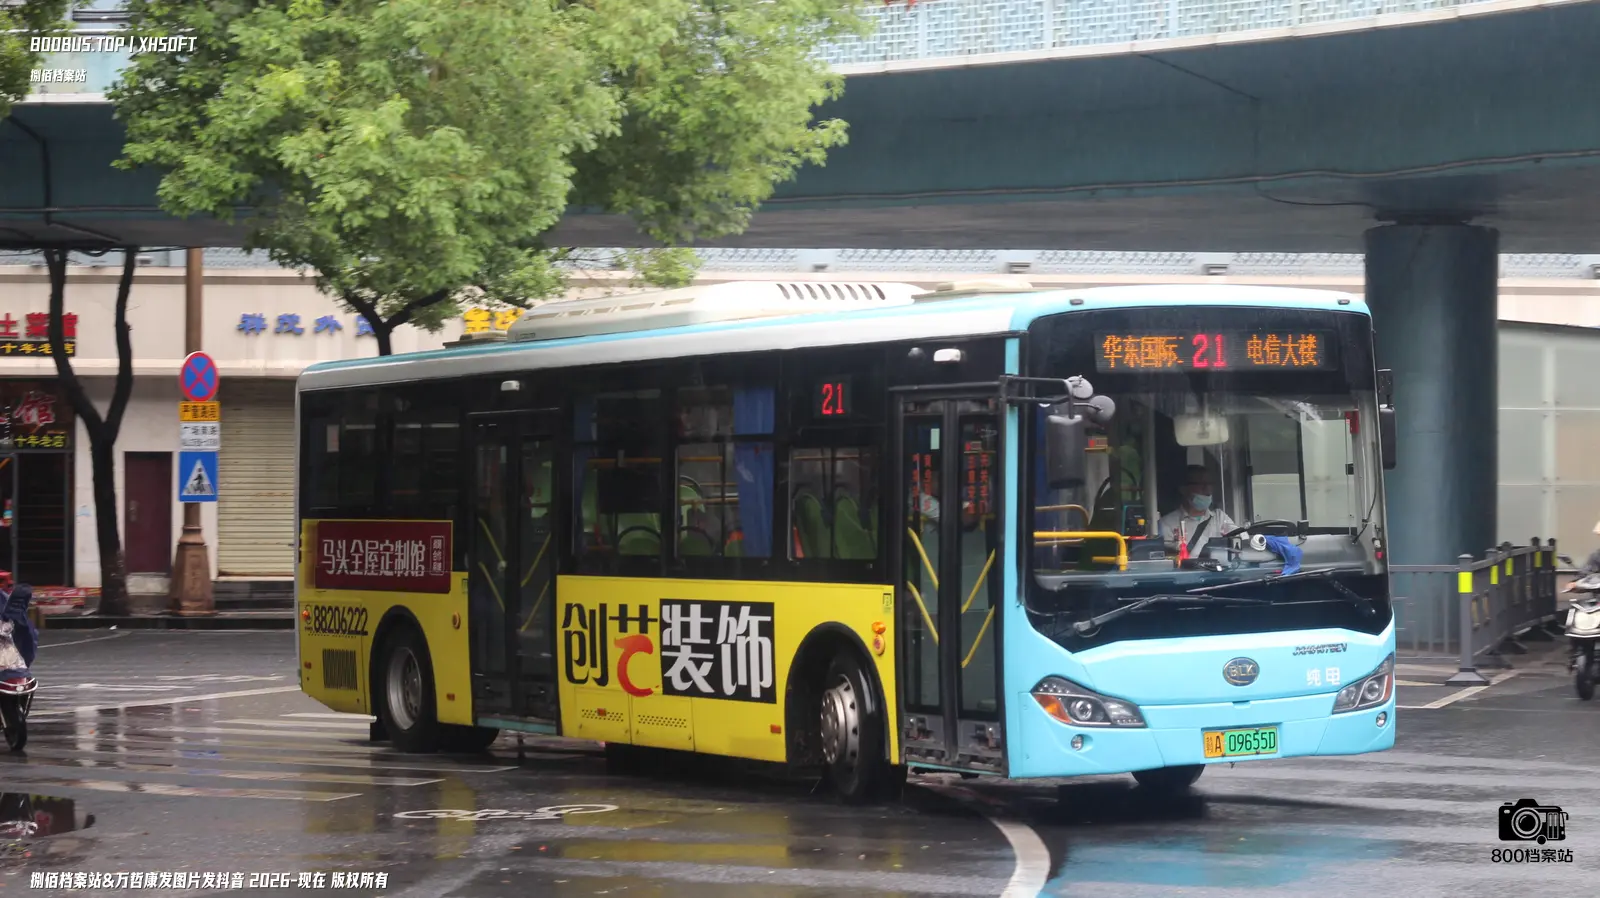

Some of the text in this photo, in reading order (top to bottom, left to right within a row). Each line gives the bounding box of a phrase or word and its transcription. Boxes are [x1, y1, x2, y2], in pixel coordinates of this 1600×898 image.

[1192, 334, 1227, 368] 21
[1247, 334, 1318, 366] 电信大楼
[822, 383, 845, 415] 21
[313, 605, 368, 636] 88206222
